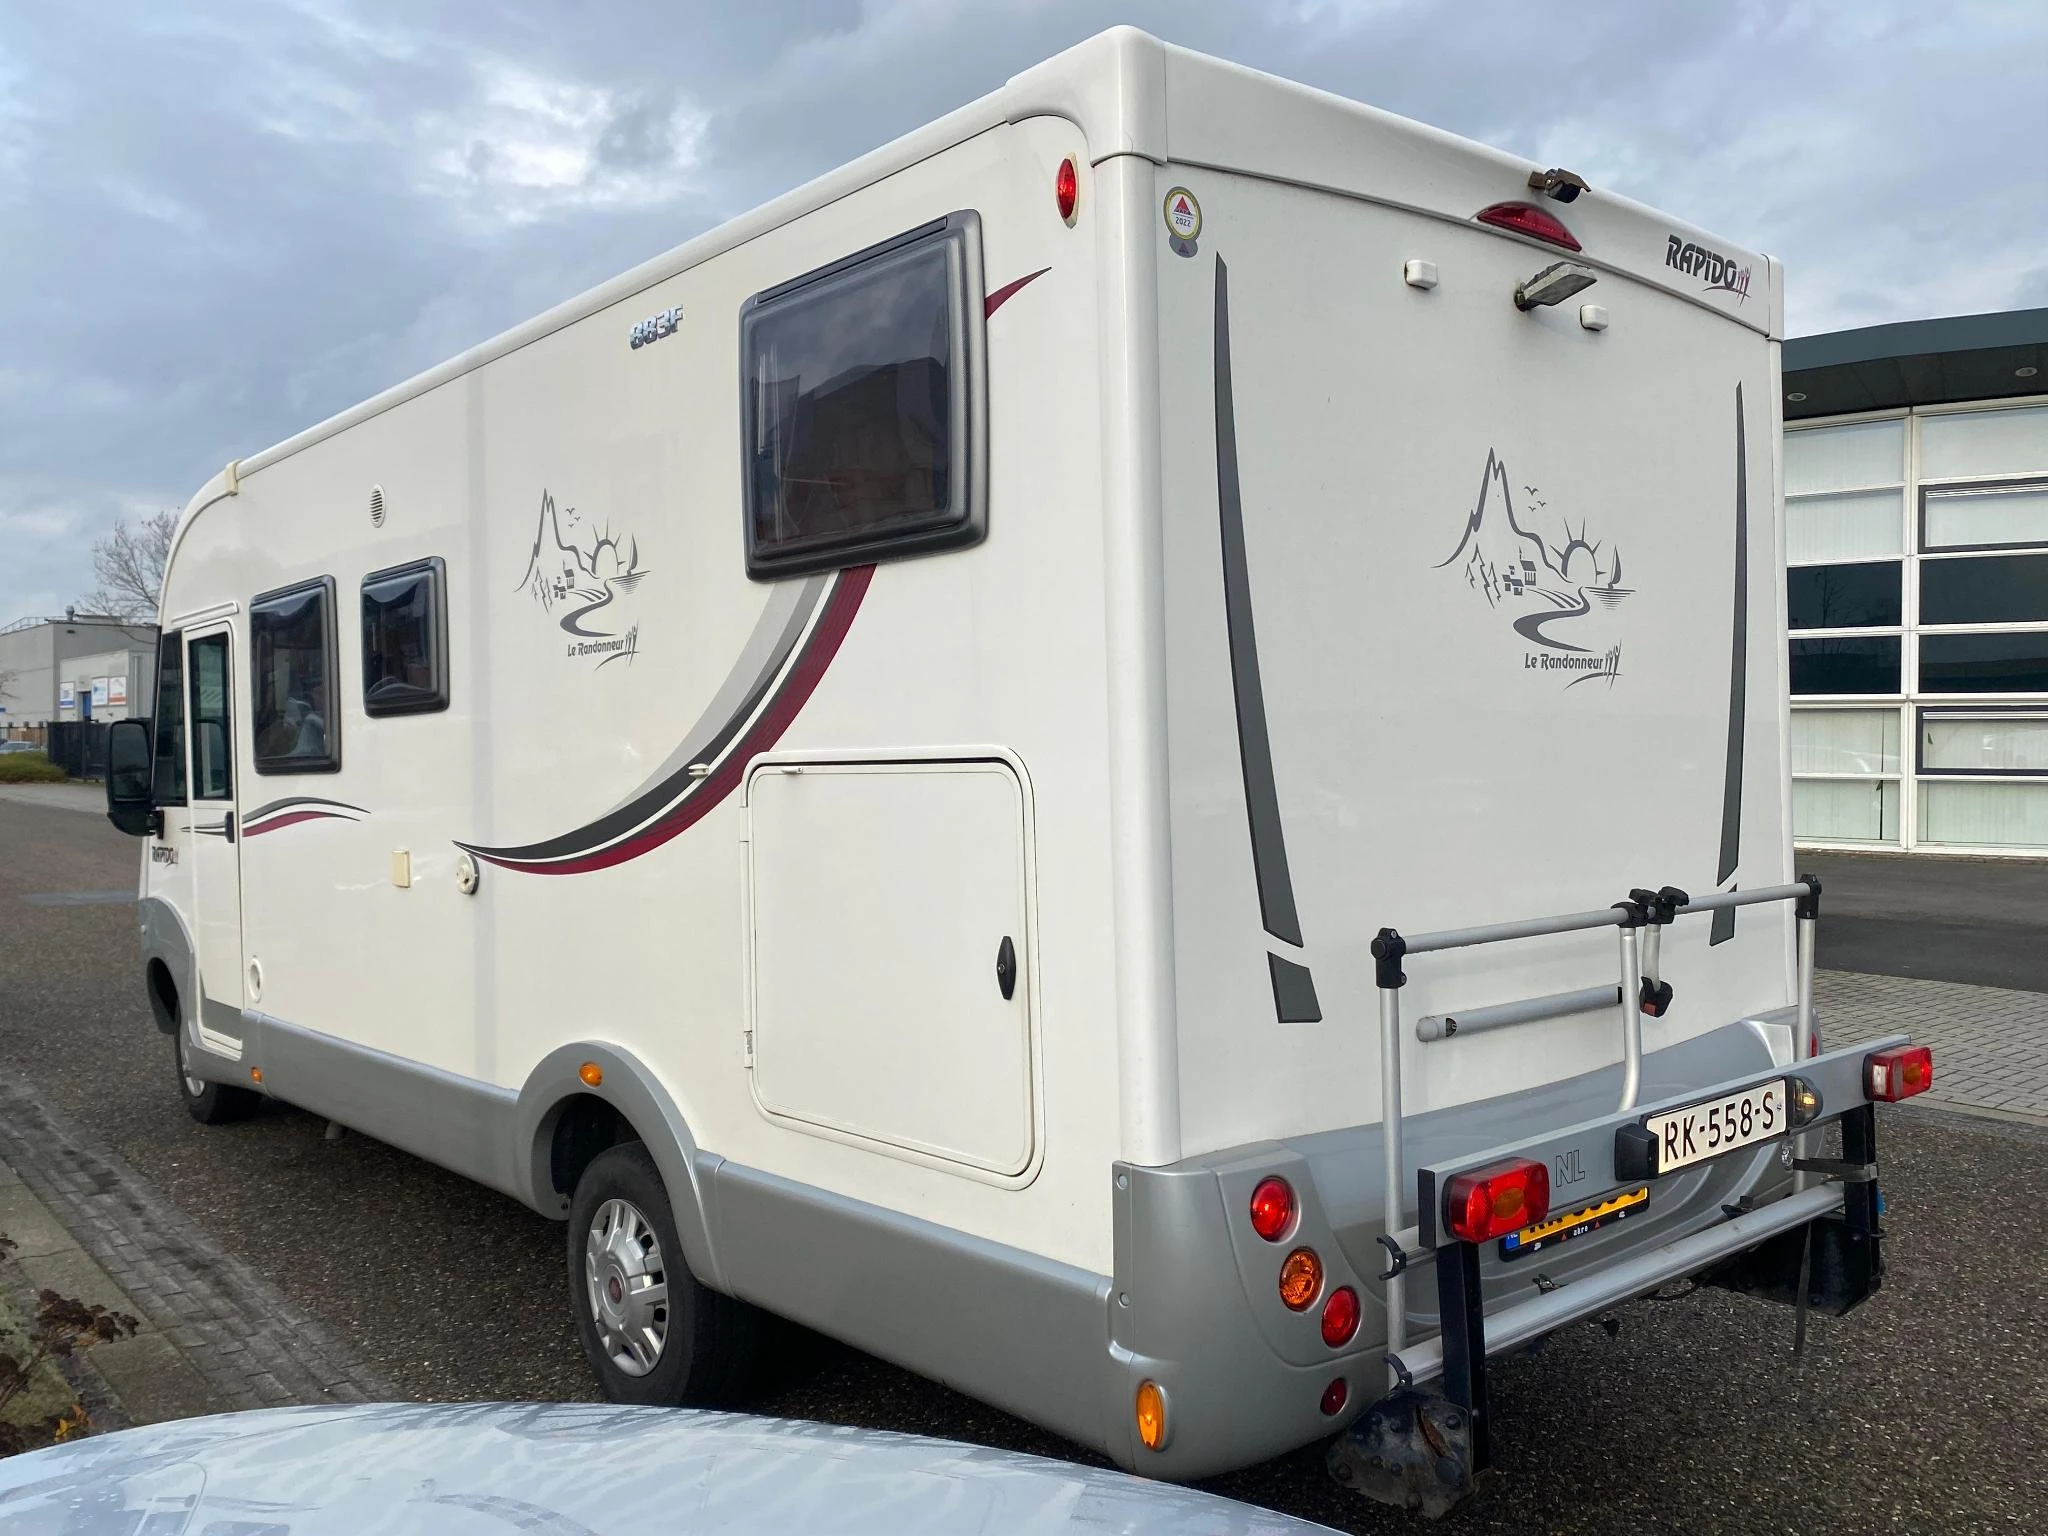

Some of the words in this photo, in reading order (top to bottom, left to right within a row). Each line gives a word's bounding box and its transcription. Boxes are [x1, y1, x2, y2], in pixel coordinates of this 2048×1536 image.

[1175, 216, 1191, 227] 2022
[630, 303, 684, 350] 883F
[567, 644, 577, 657] Le
[577, 640, 624, 656] Randonneur
[1524, 652, 1538, 669] Le
[1540, 653, 1604, 670] Randonneur
[1664, 1091, 1775, 1164] RK-558-S
[1555, 1149, 1586, 1188] NL
